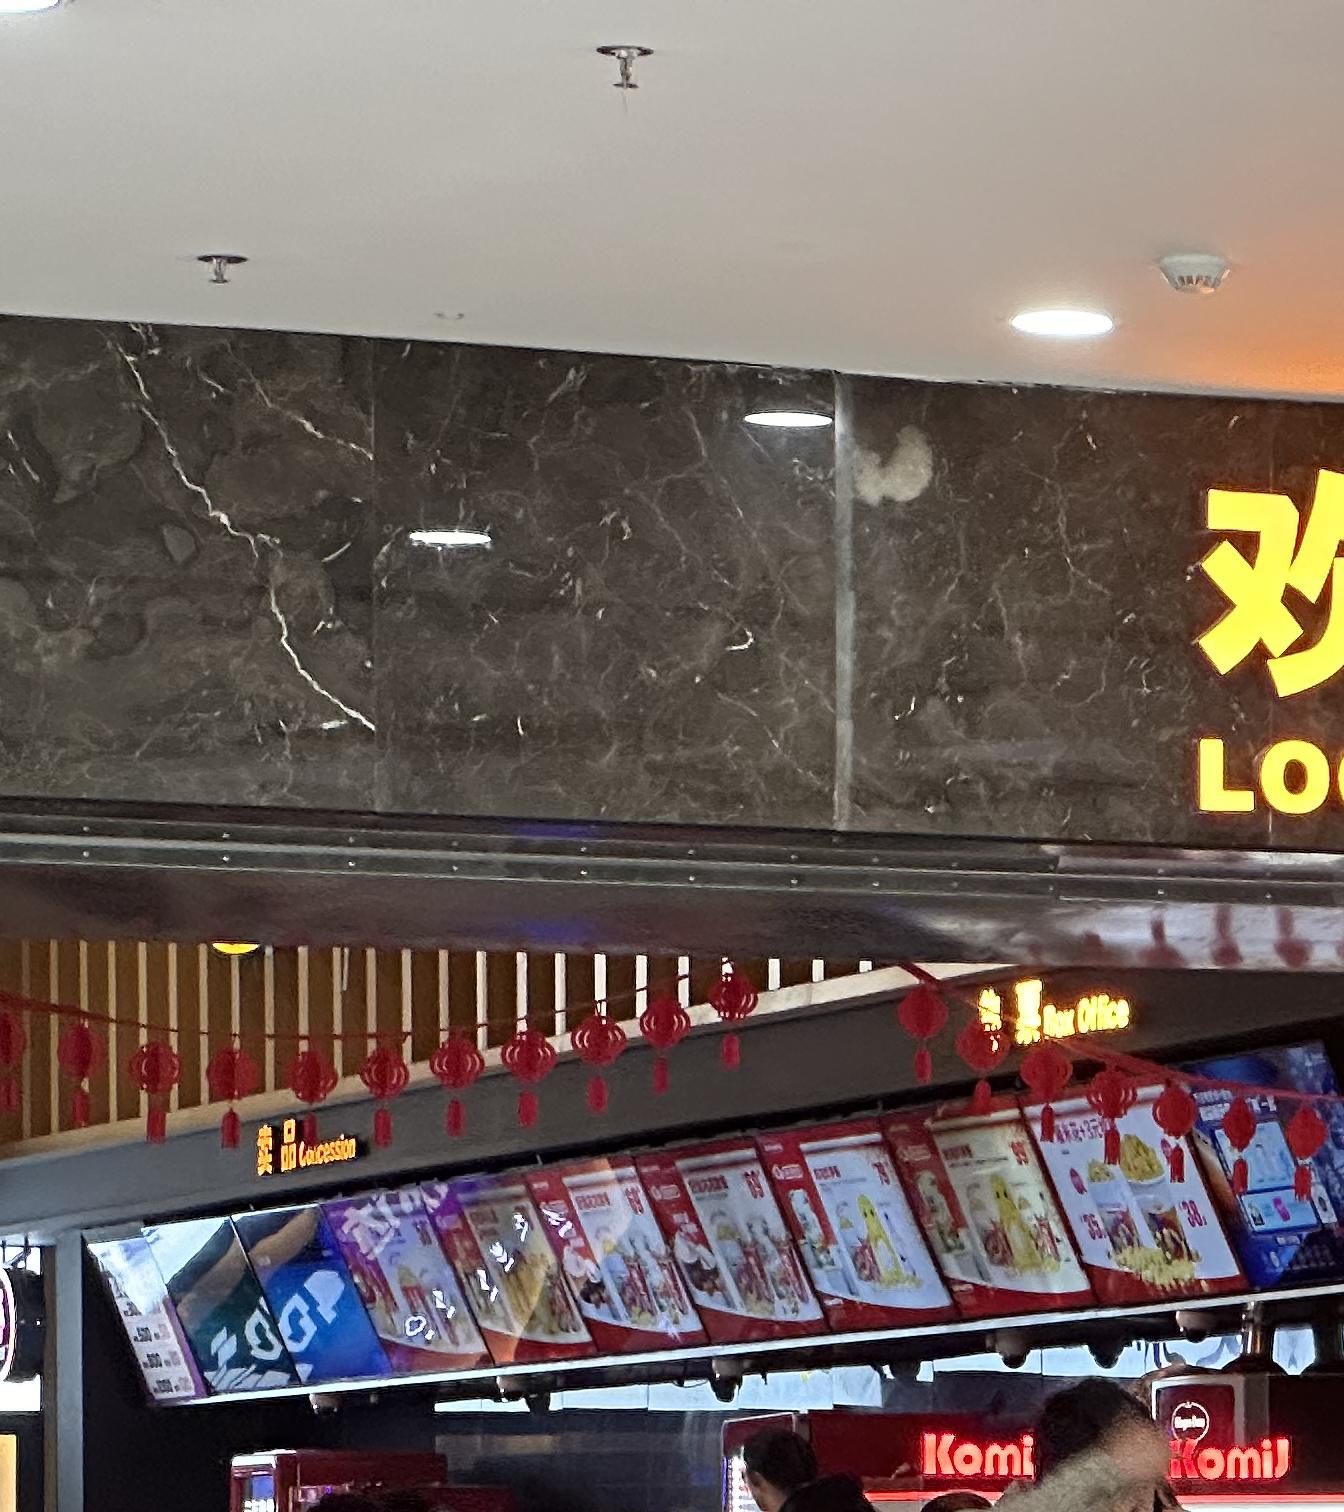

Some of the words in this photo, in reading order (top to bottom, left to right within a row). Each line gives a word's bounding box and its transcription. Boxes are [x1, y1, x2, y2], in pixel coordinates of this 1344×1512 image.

[1077, 993, 1130, 1033] Office
[299, 1133, 356, 1167] Concession
[1167, 1437, 1290, 1480] KomiJ
